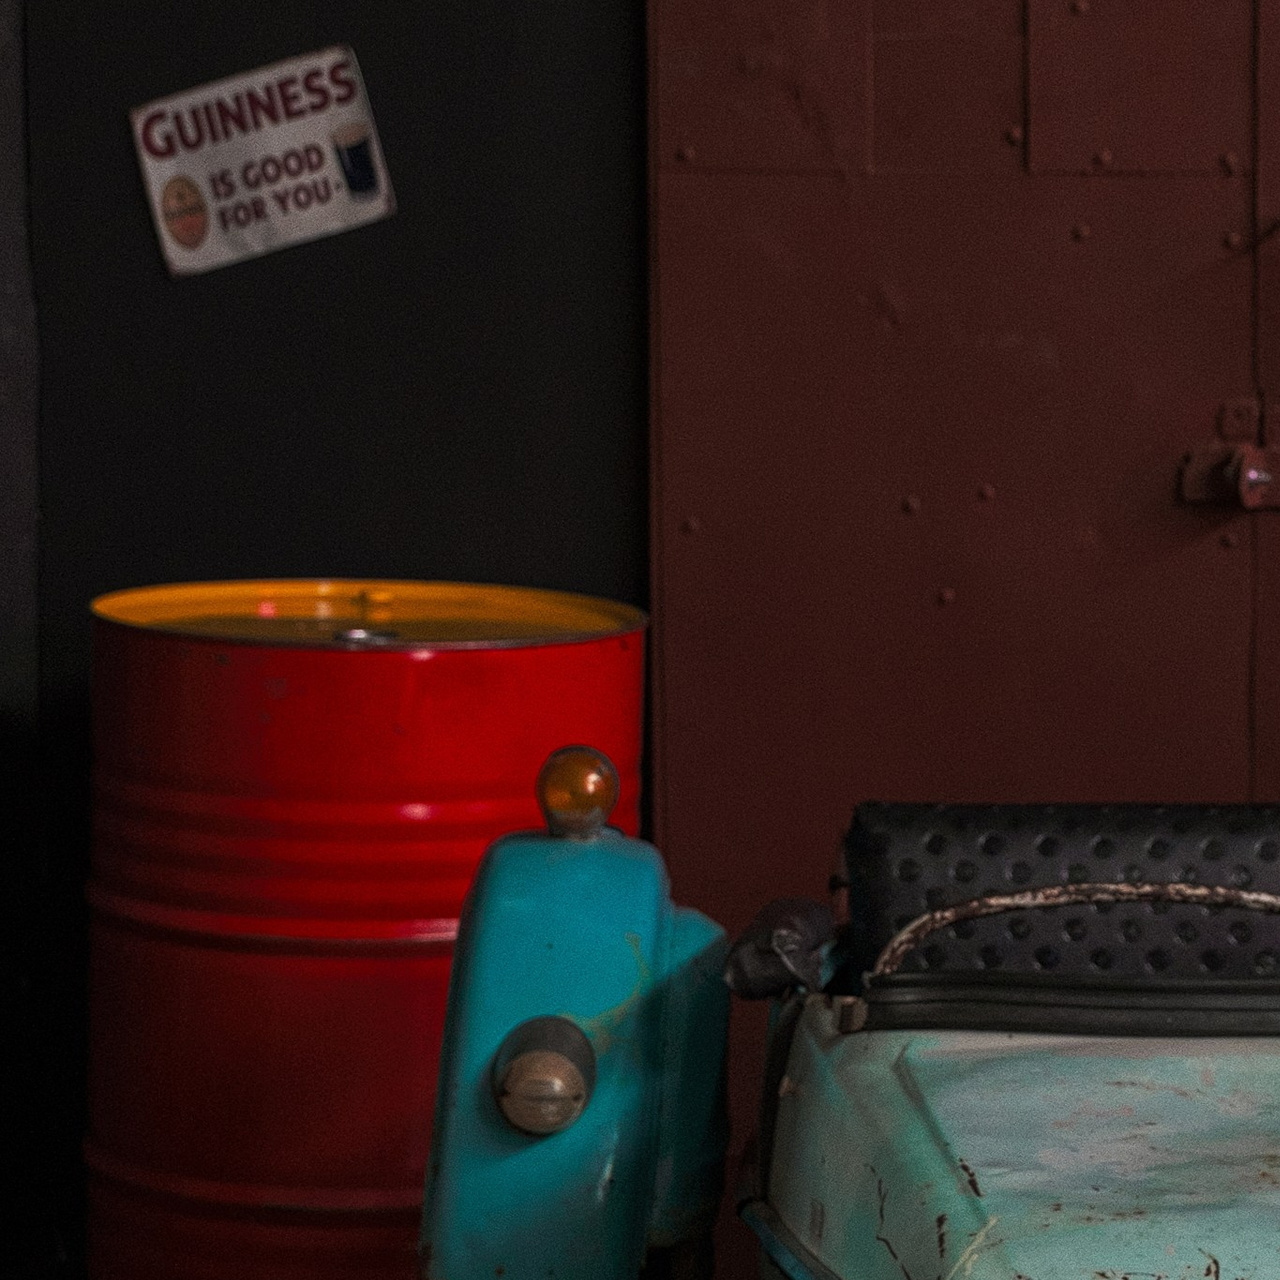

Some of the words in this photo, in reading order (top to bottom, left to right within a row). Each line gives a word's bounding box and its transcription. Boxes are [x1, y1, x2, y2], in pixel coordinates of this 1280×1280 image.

[141, 62, 358, 158] GUINNESS
[210, 168, 235, 201] IS
[241, 144, 324, 190] GOOD
[218, 198, 268, 233] FOR
